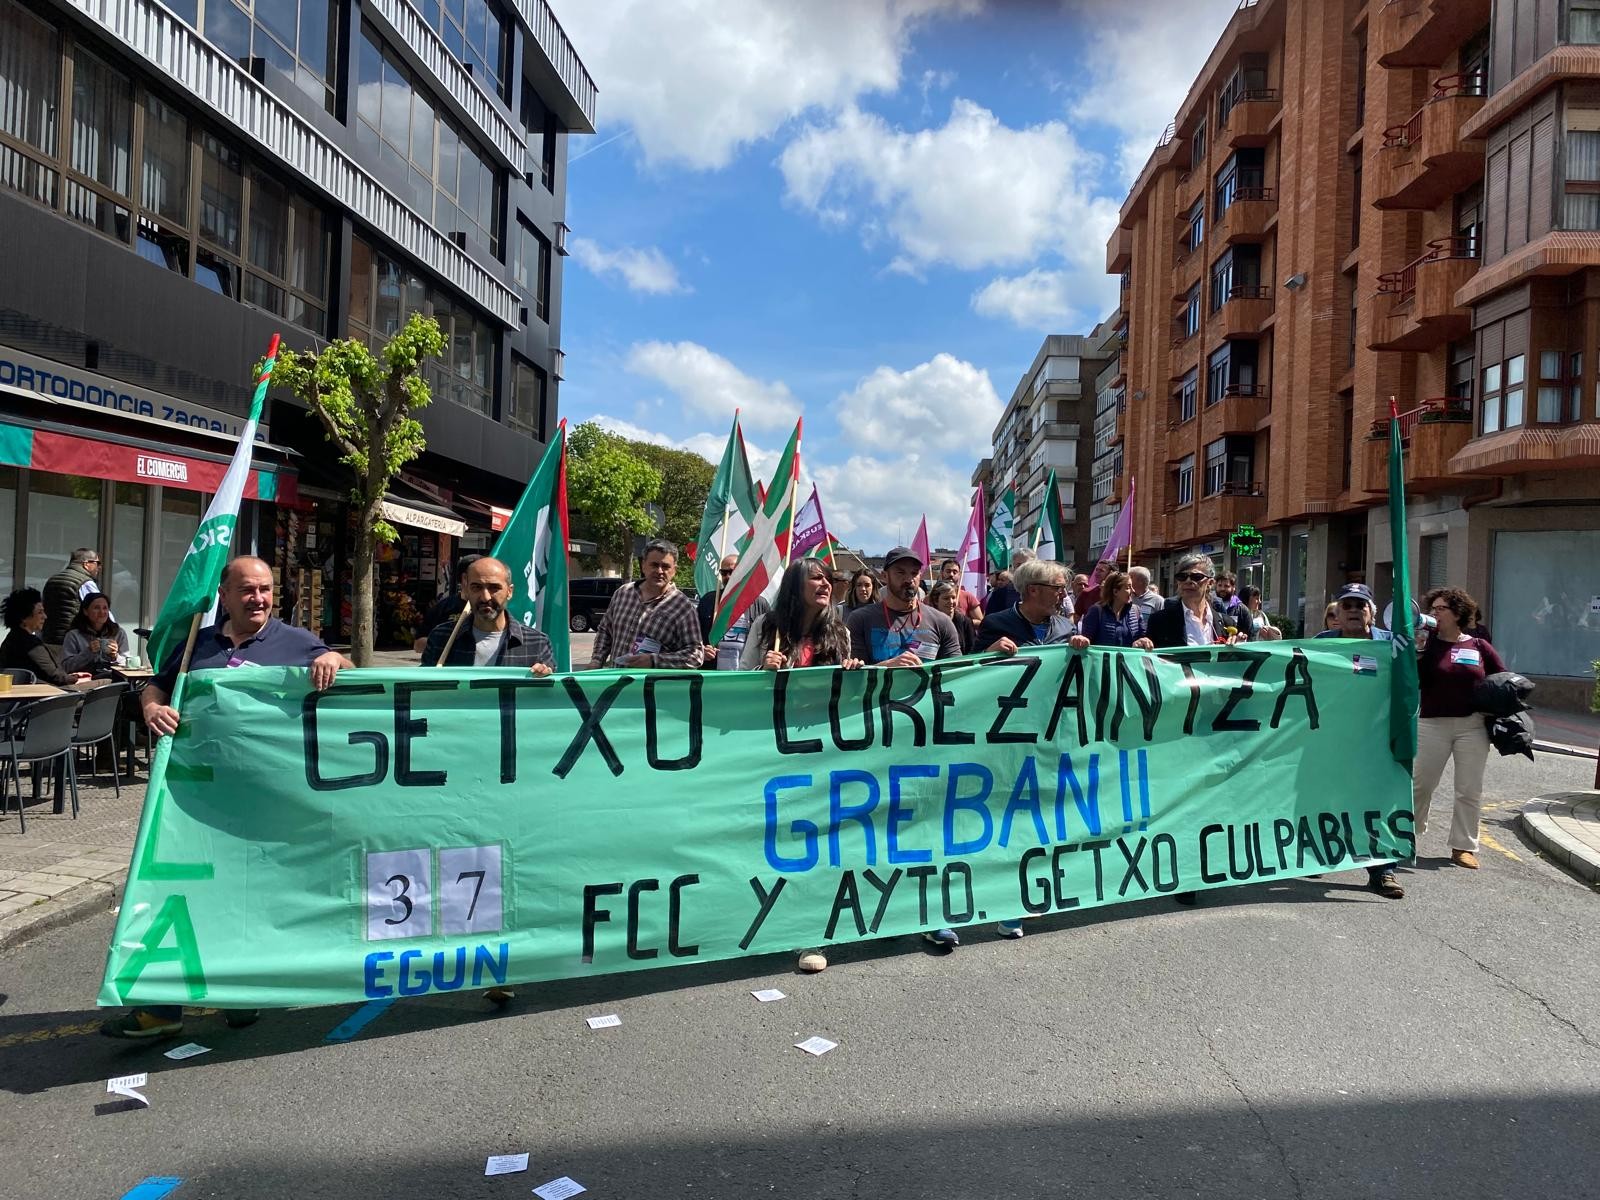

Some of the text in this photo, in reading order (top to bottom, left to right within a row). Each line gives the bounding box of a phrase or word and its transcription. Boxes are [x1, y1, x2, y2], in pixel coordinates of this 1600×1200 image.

[137, 457, 188, 481] EL COMERCIO
[303, 674, 703, 790] GETXO
[582, 809, 1416, 964] FCC Y AYTO. GETXO CULPABLES
[364, 943, 509, 998] EGUN
